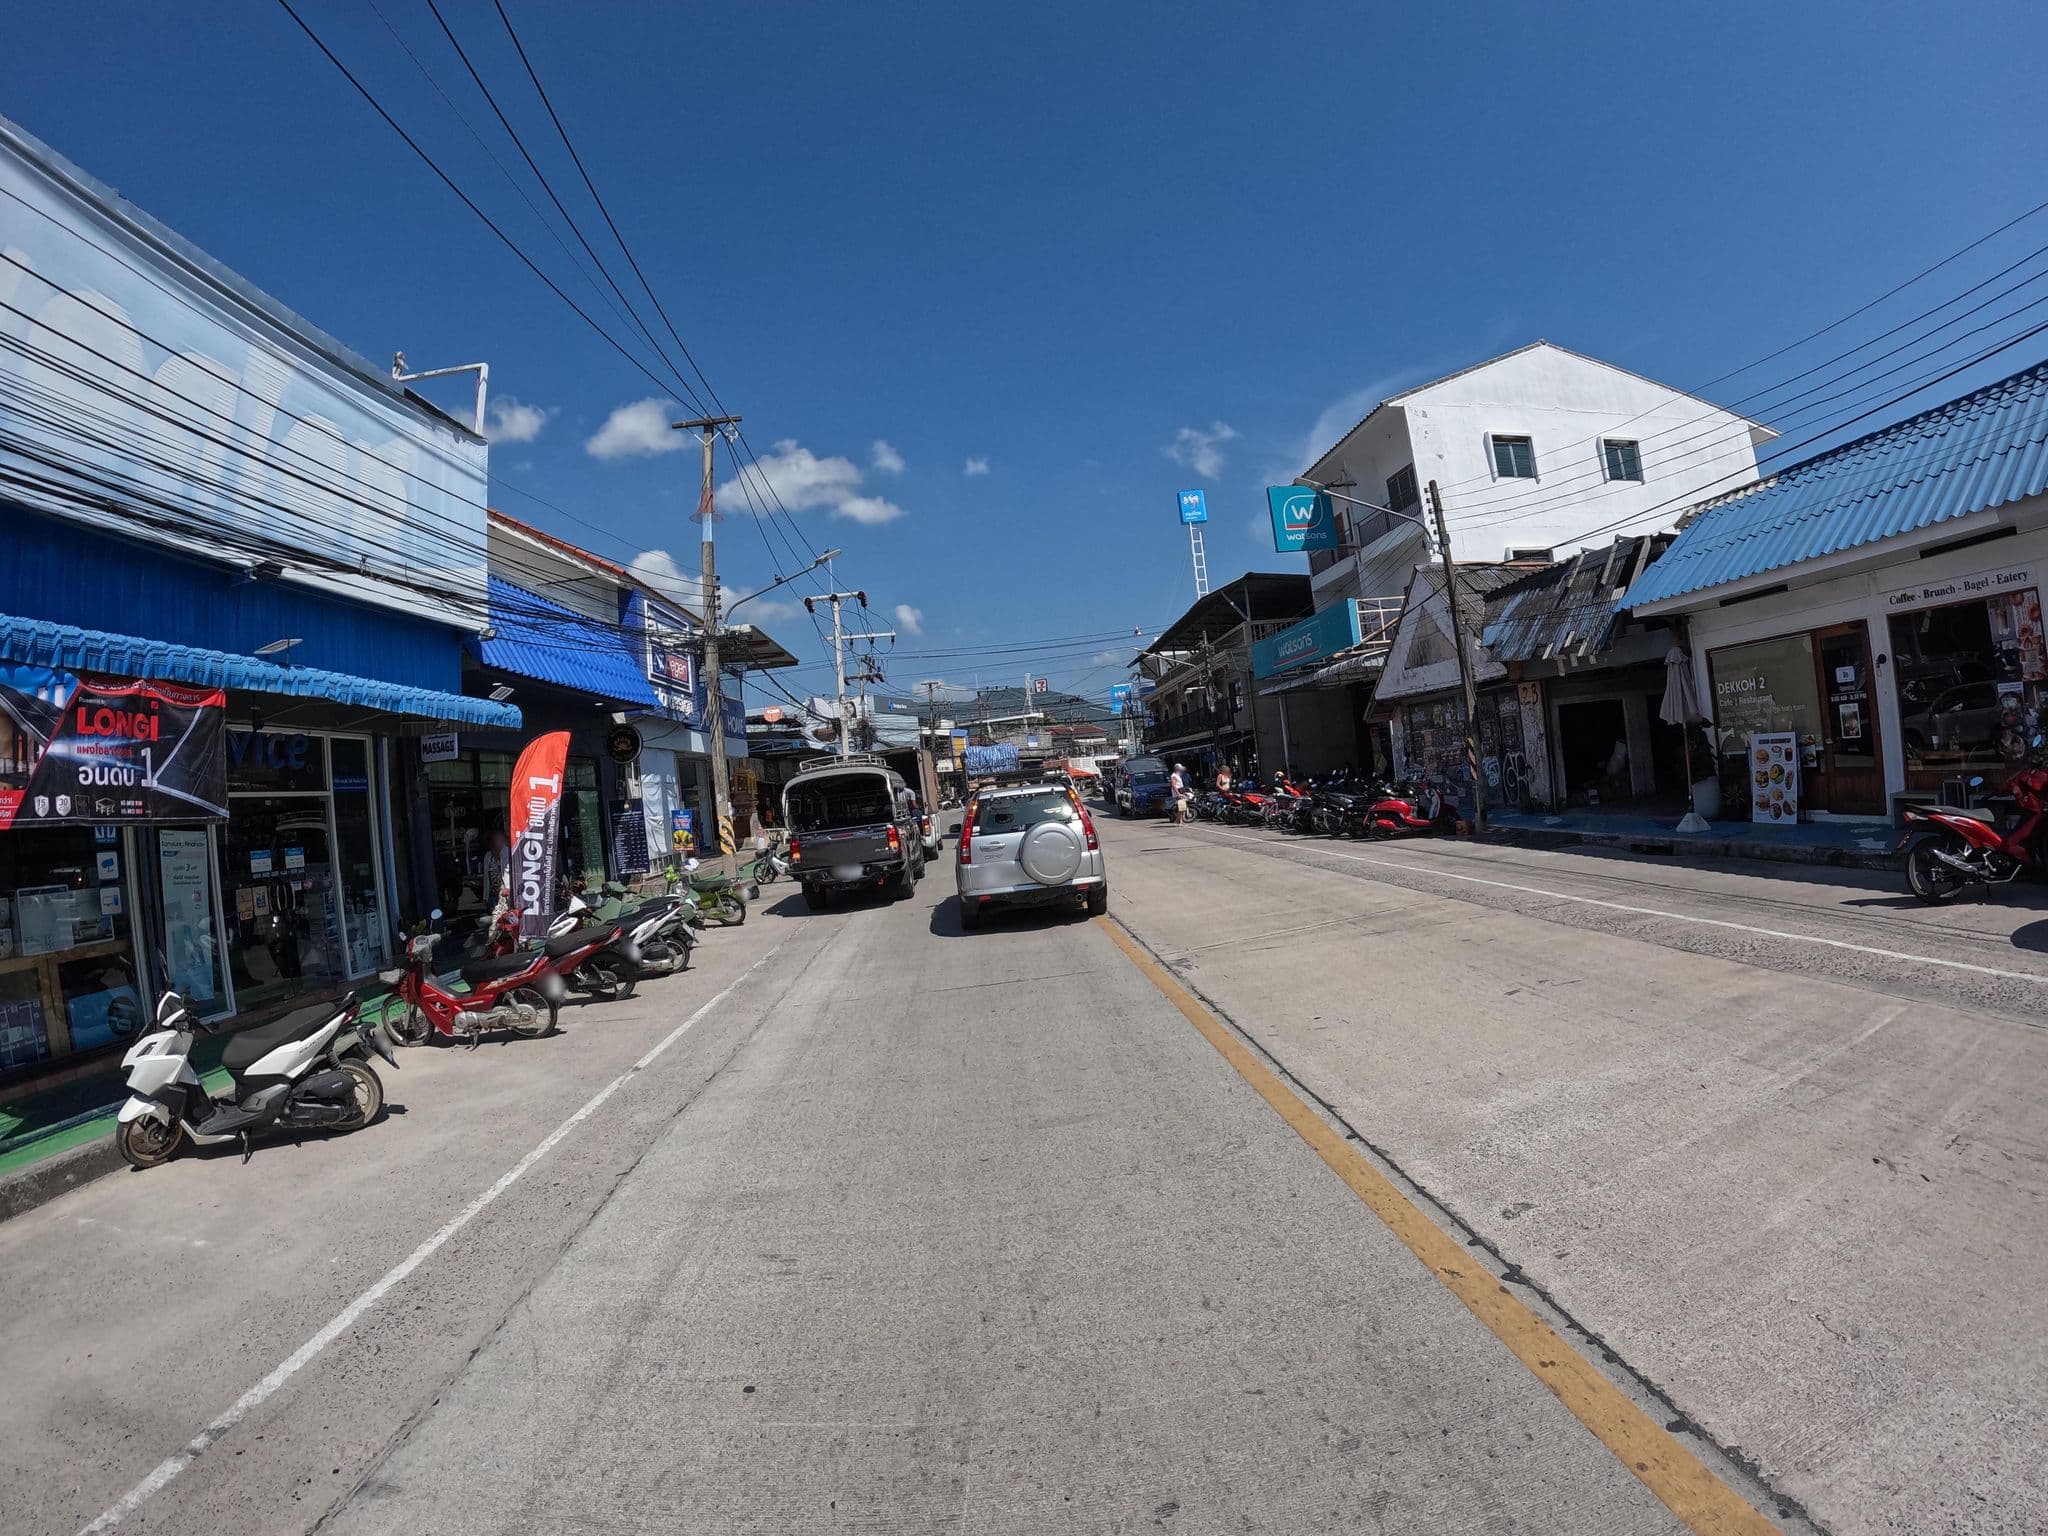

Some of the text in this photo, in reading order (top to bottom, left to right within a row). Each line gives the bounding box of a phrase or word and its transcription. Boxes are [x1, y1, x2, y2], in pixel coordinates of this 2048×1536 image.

[1286, 531, 1328, 541] watsons
[1889, 569, 2029, 606] Coffee Brunch Bagel Eatery
[1278, 632, 1313, 657] watsons
[1718, 677, 1766, 695] DEKKOH 2
[422, 740, 455, 755] MASSAGE
[141, 747, 157, 787] 1
[529, 774, 560, 794] 1
